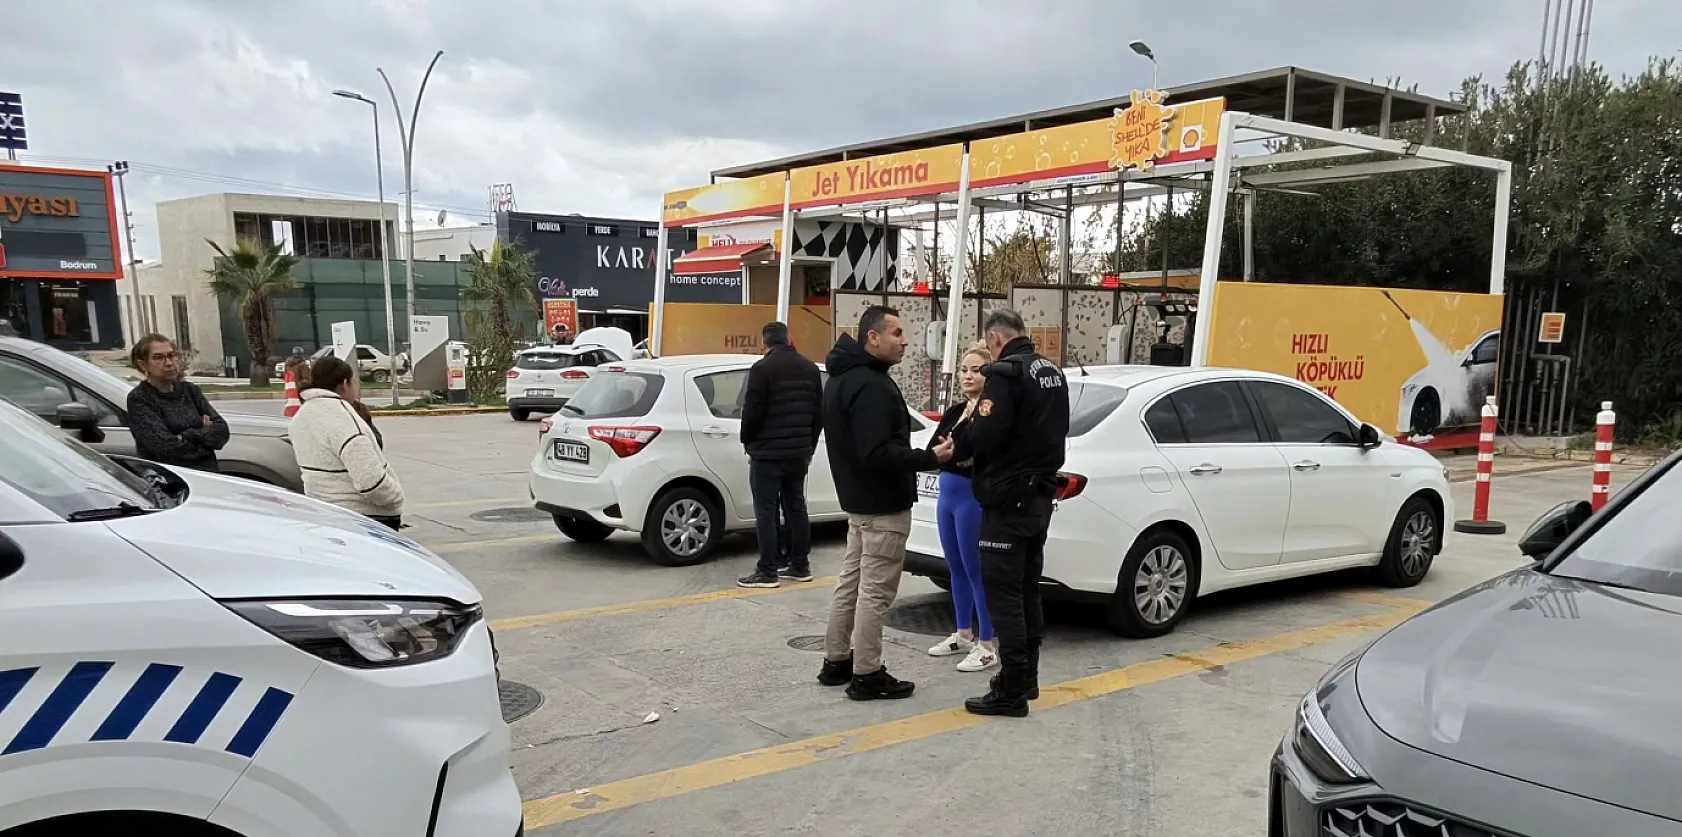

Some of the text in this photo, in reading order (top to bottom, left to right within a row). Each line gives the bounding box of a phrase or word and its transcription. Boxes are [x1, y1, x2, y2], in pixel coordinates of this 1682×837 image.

[1124, 138, 1150, 161] YIKA
[812, 160, 929, 197] Jet Yıkama
[60, 260, 97, 269] Bodrum
[669, 273, 742, 287] home concept
[571, 286, 599, 298] perde
[724, 334, 757, 348] HIZLI
[1291, 333, 1328, 354] HIZLI
[1295, 355, 1364, 382] KÖPÜKLÜ
